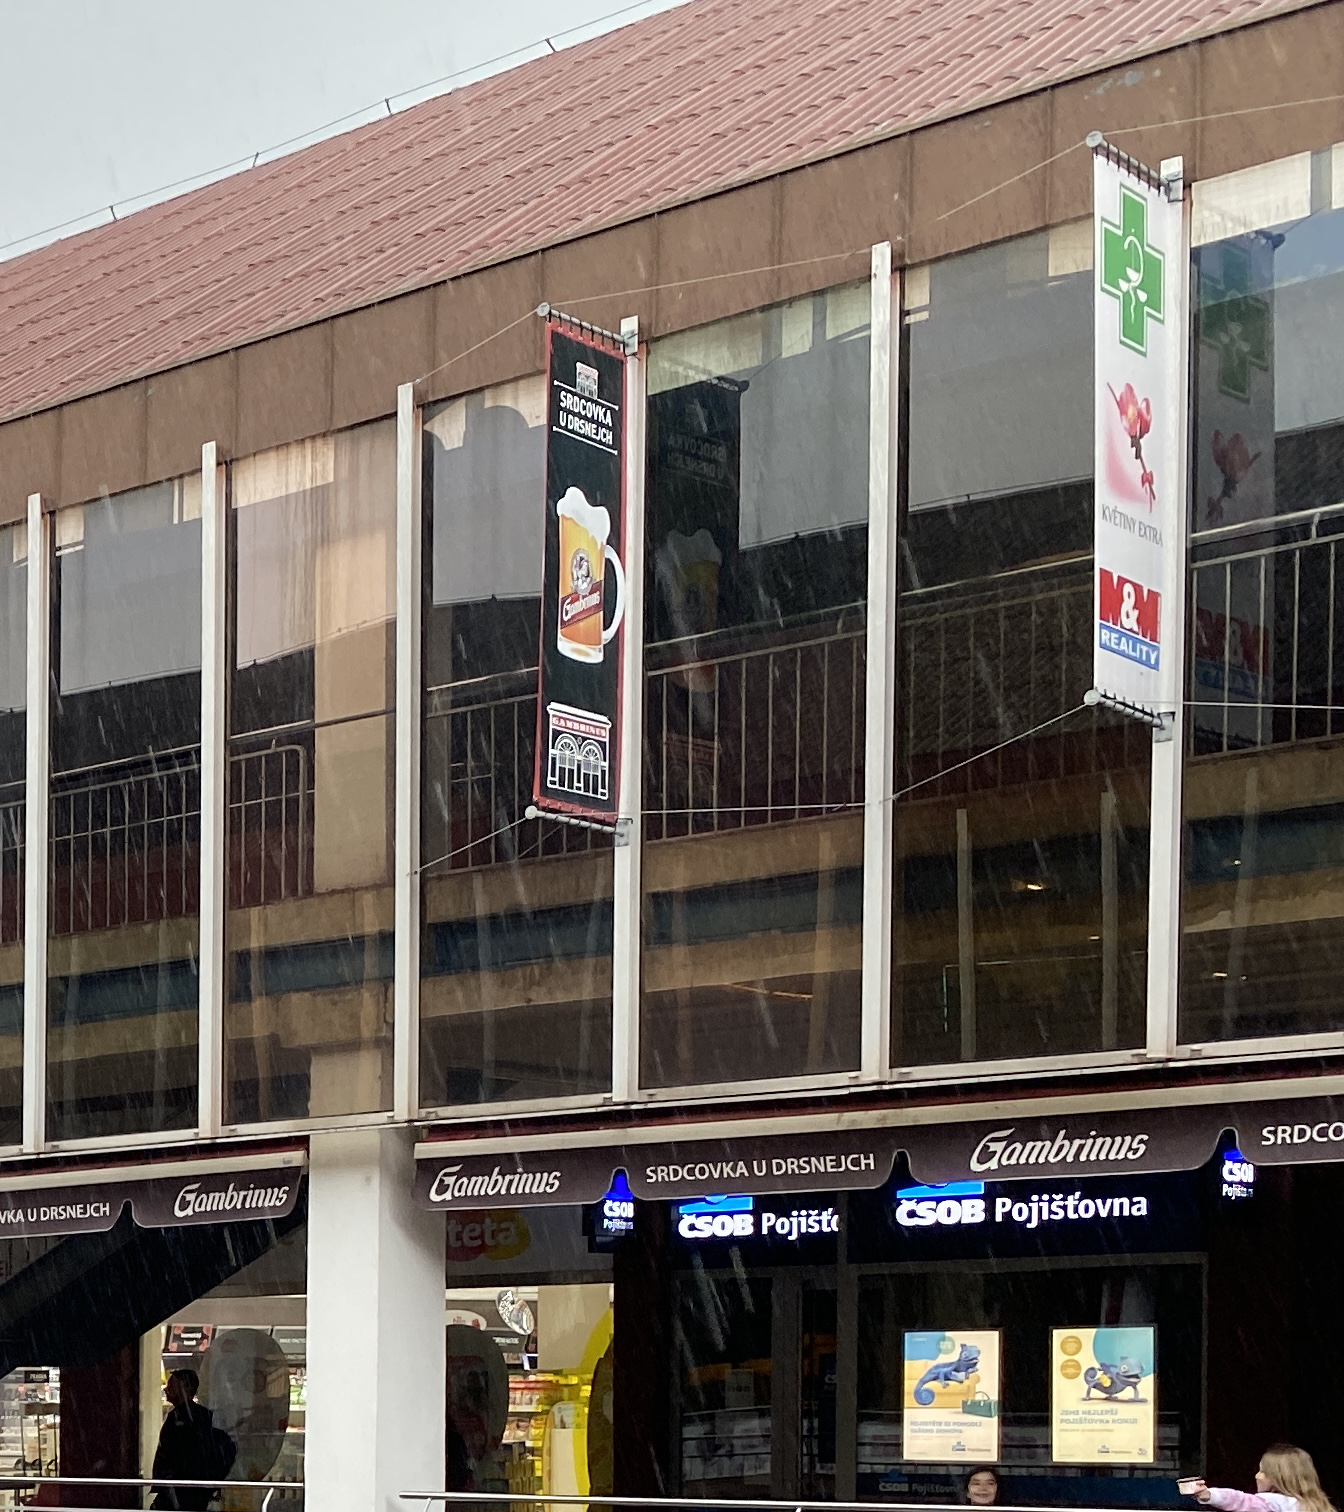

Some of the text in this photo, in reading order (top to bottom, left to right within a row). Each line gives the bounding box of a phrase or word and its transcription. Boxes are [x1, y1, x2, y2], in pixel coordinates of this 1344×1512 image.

[560, 391, 612, 427] SRDCOVKA
[559, 411, 613, 445] U DRSNEJCH
[1102, 503, 1163, 547] KVĚTINY EXTRA
[1099, 567, 1161, 644] M&M
[1100, 629, 1158, 665] REALITY
[970, 1127, 1149, 1172] Gambrinus
[1262, 1122, 1344, 1145] SRDCO
[429, 1164, 561, 1202] Gambrinus
[646, 1153, 875, 1183] SRDCOVKA U DRSNEJCH
[28, 1206, 37, 1222] U
[40, 1202, 110, 1221] DRSNEJCH
[173, 1182, 289, 1218] Gambrinus
[603, 1200, 634, 1218] ČSOB
[895, 1191, 1148, 1228] ČSOB Pojišťovna
[447, 1216, 519, 1247] teta
[678, 1208, 839, 1240] ČSOB Pojišť
[912, 1482, 957, 1495] Pojišťovn
